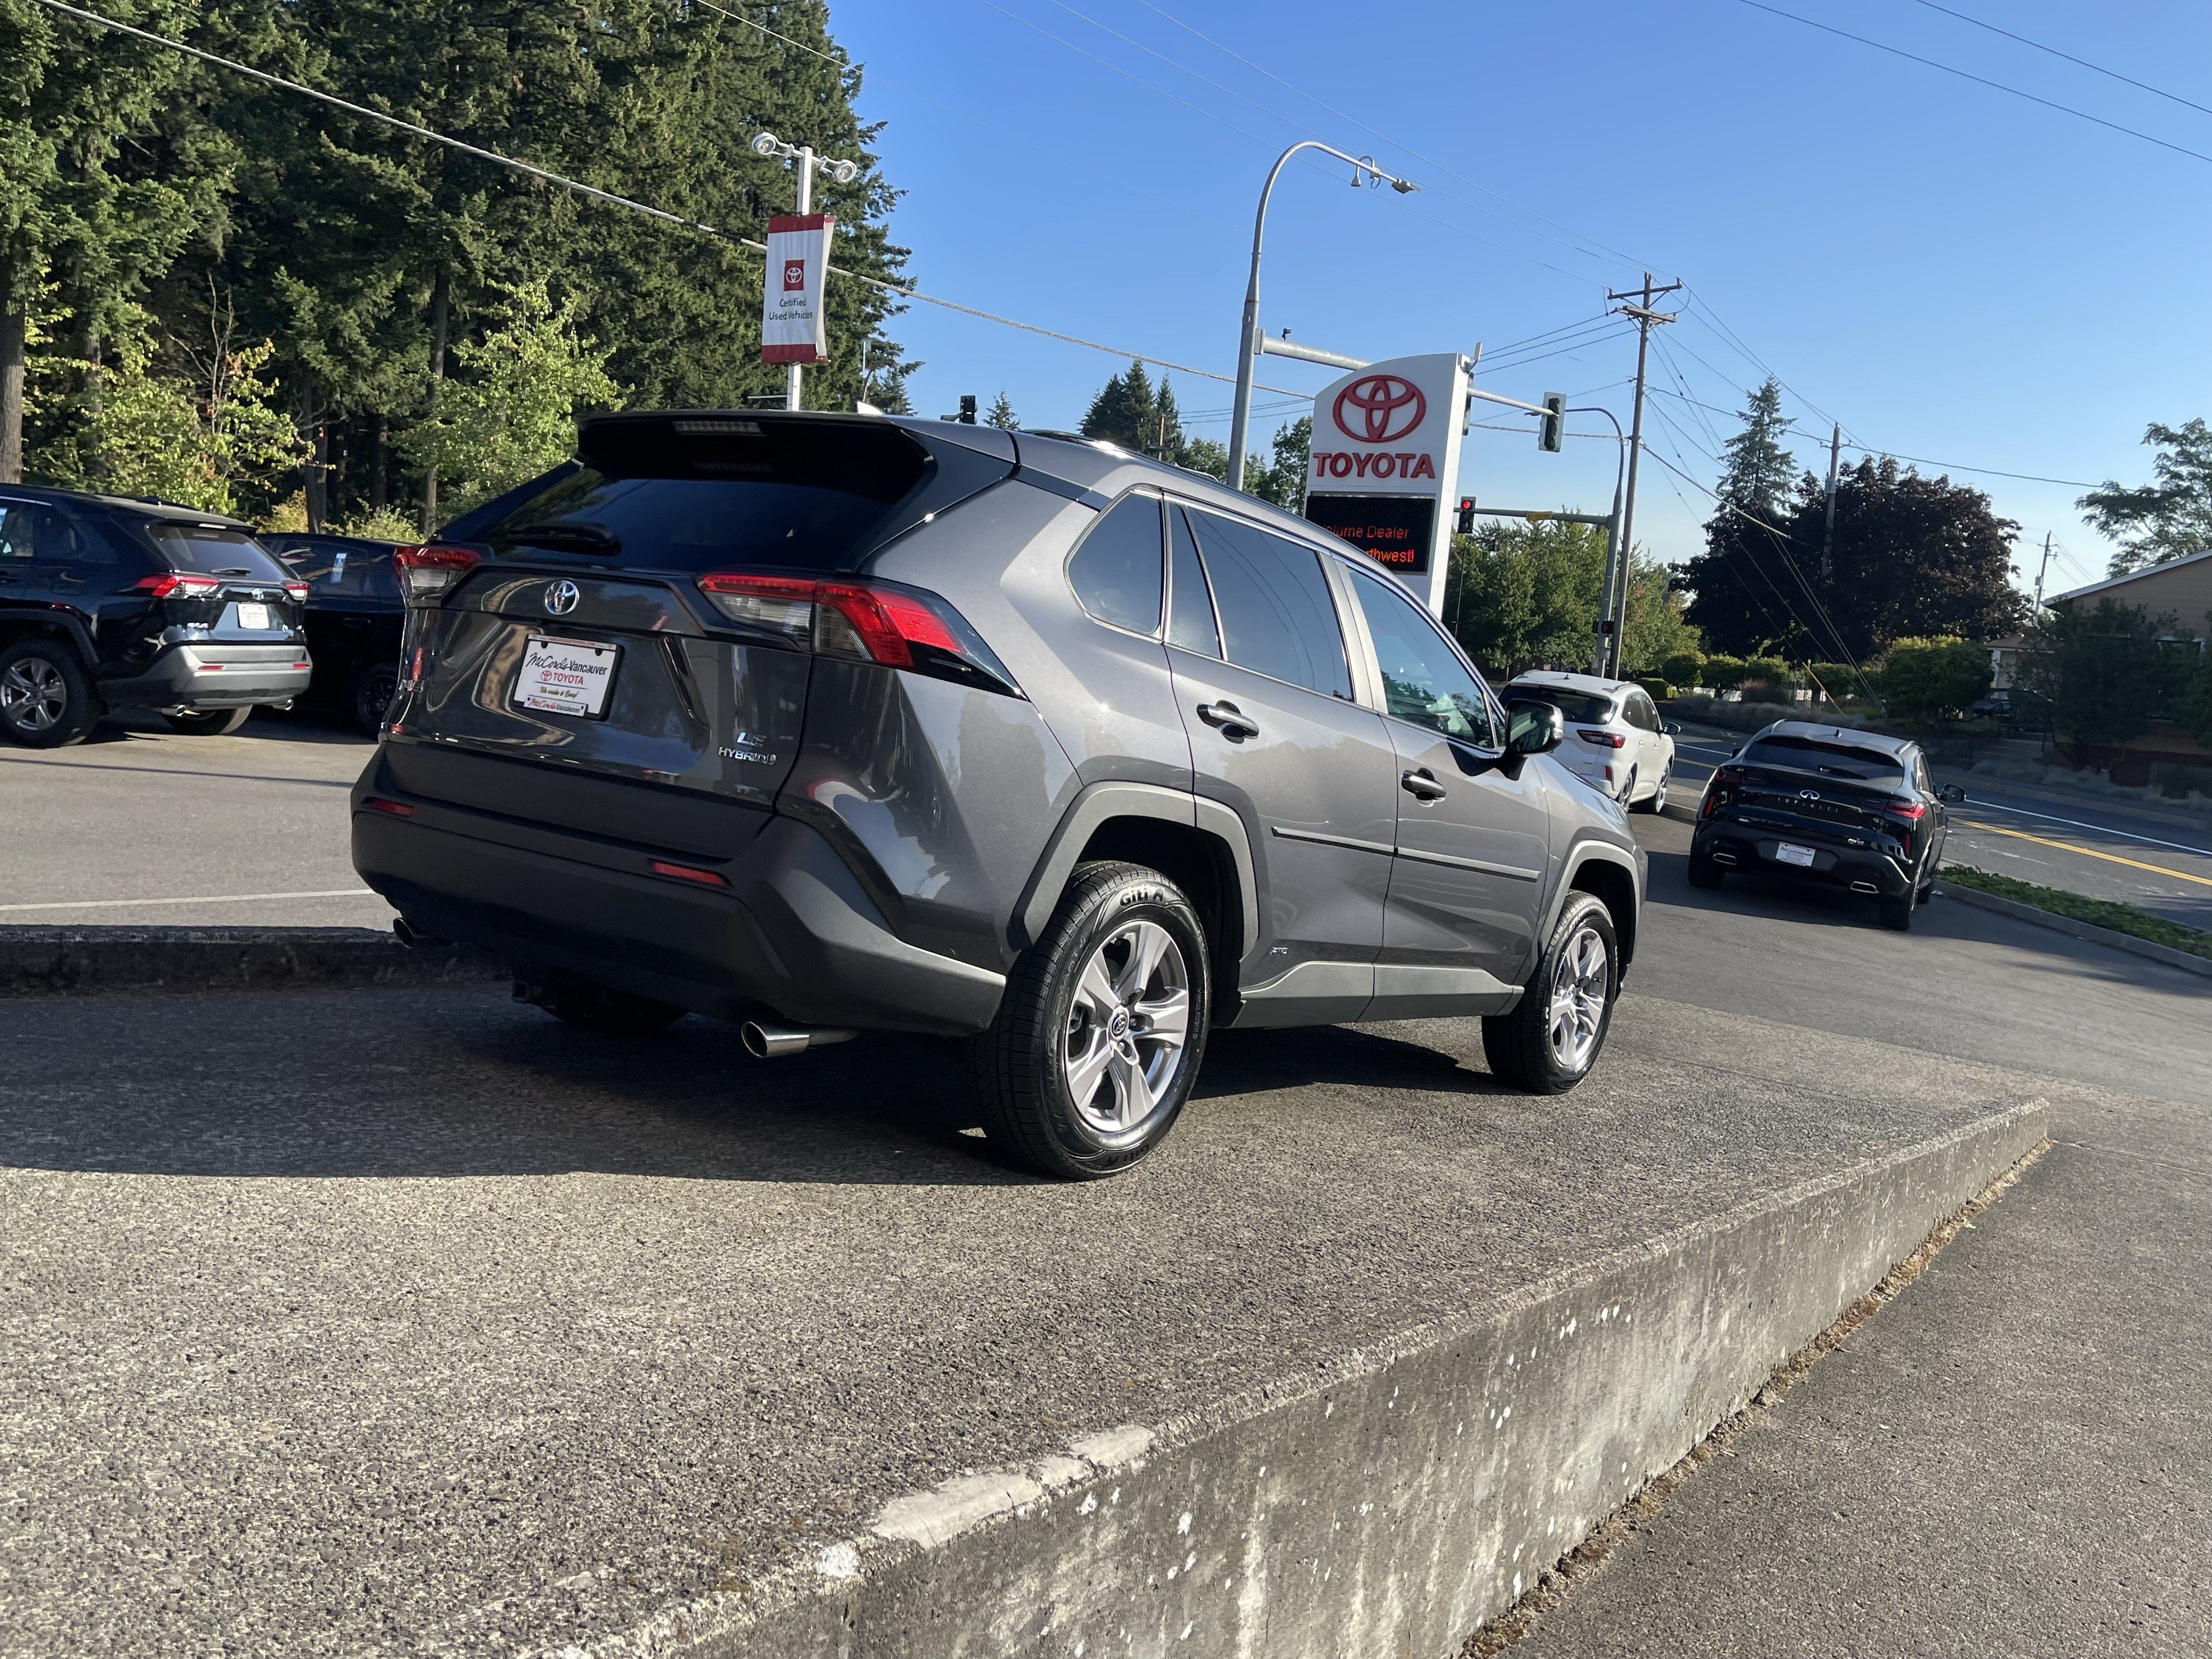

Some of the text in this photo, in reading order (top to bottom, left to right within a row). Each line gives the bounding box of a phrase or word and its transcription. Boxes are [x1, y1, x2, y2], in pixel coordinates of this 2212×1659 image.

[780, 297, 806, 307] Certified
[769, 310, 813, 320] Used Vehicles
[1313, 452, 1436, 479] TOYOTA
[1323, 523, 1409, 539] olume Dealer
[554, 672, 584, 685] TOYOTA
